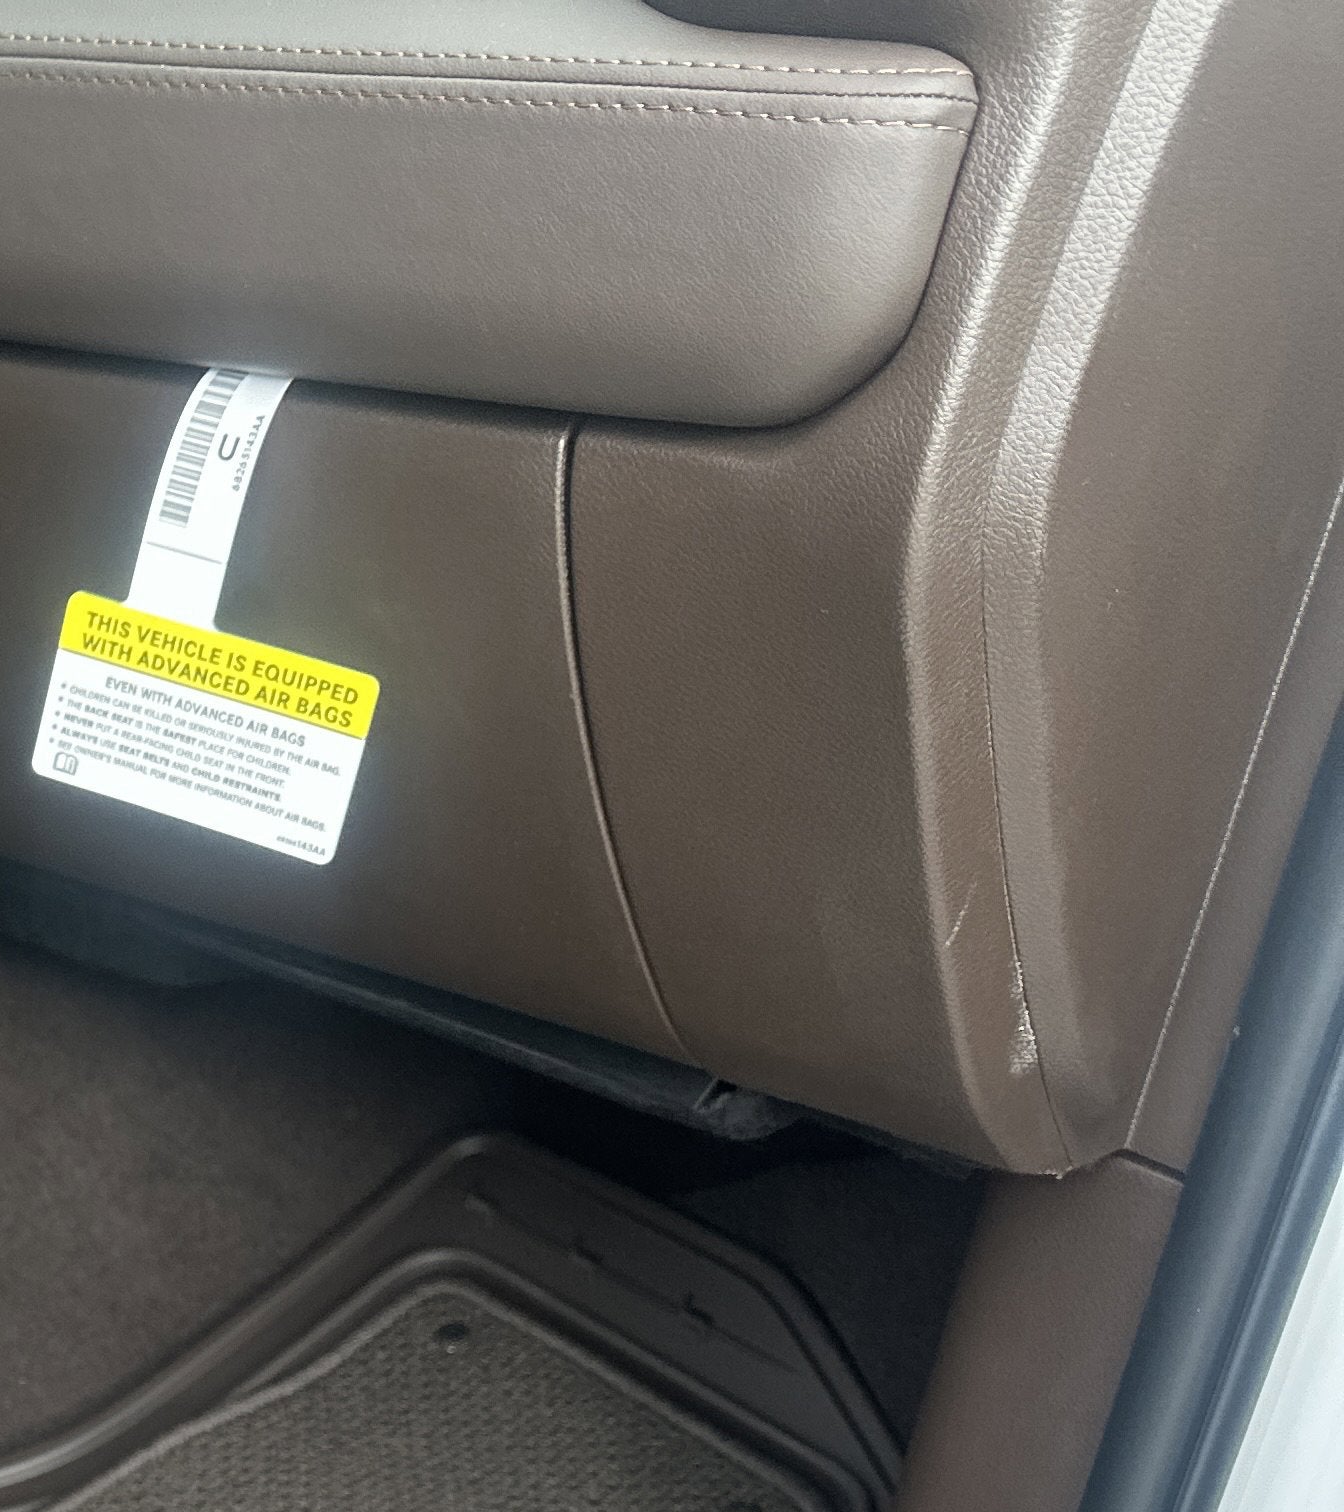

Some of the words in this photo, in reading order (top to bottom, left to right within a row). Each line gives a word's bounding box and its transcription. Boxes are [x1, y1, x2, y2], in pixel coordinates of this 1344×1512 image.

[83, 634, 133, 661] WITH
[137, 651, 250, 695] ADVANCED
[254, 686, 291, 708] AIR
[296, 697, 352, 727] BAGS
[88, 612, 131, 637] THIS
[138, 626, 222, 663] VEHICLE
[226, 652, 247, 671] IS
[252, 660, 358, 704] EQUIPPED
[106, 677, 137, 695] EVEN
[142, 688, 172, 705] WITH
[175, 699, 243, 727] ADVANCED
[246, 720, 268, 735] AIR
[271, 727, 305, 747] BAGS
